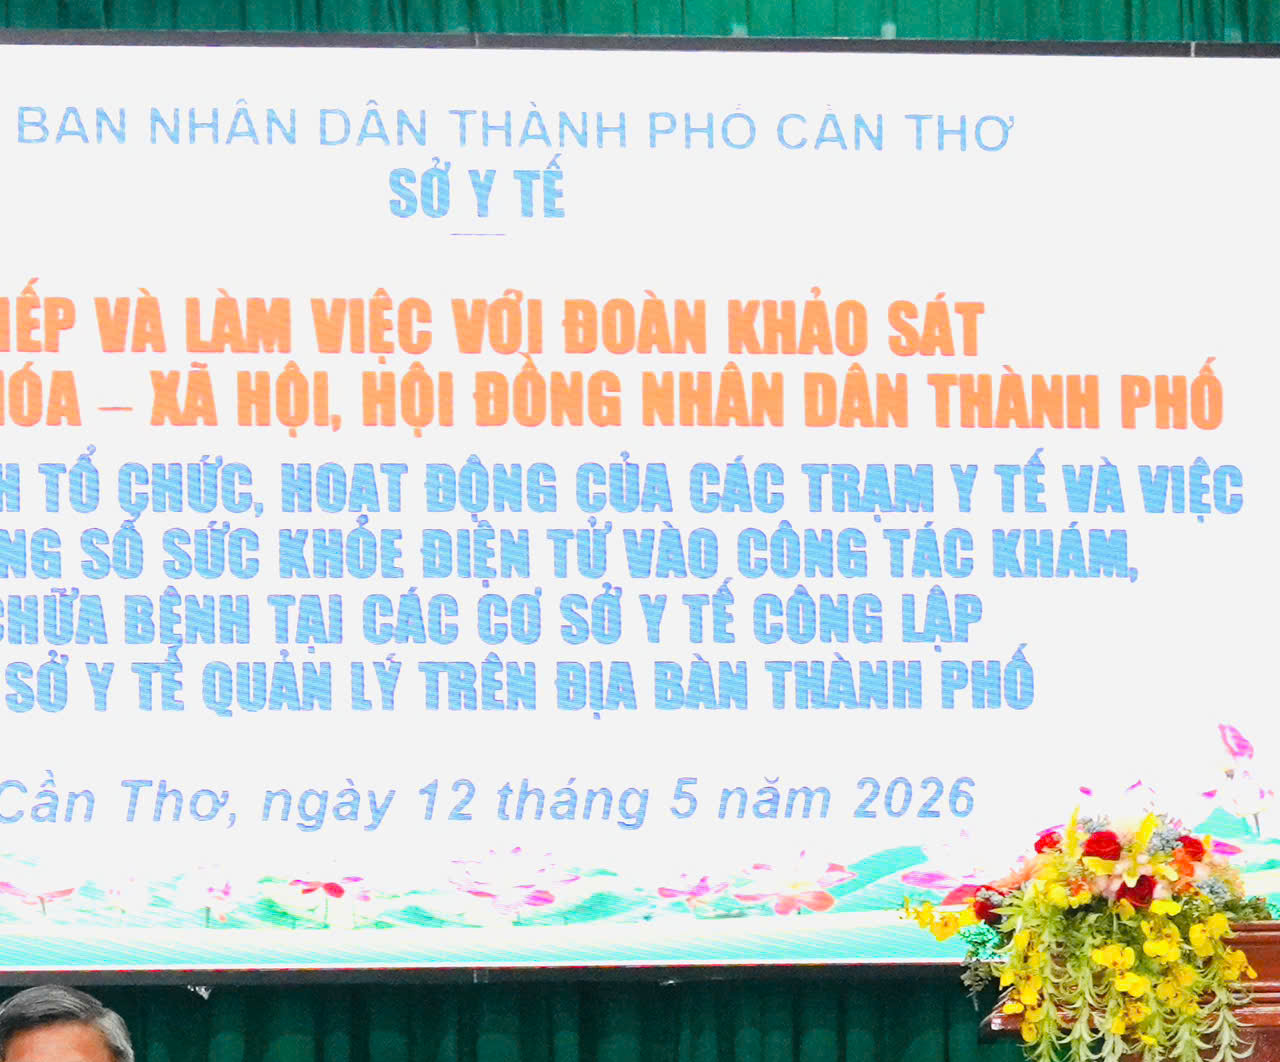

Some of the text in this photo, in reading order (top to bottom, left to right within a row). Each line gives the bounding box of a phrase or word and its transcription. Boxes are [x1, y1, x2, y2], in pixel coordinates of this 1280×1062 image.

[17, 106, 126, 144] BAN
[152, 98, 296, 144] NHÂN
[320, 100, 426, 146] DÂN
[448, 104, 627, 149] THÀNH
[904, 114, 1016, 152] THƠ
[389, 153, 565, 219] SỞ Y TẾ
[93, 288, 167, 354] VÀ
[185, 288, 292, 354] LÀM
[310, 288, 432, 365] VIỆC
[561, 290, 707, 355] ĐOÀN
[728, 286, 869, 357] KHẢO
[888, 291, 986, 357] SÁT
[148, 362, 219, 427] XÃ
[236, 360, 343, 440] HỘI,
[362, 361, 454, 437] HỘI
[472, 352, 622, 428] ĐỒNG
[641, 361, 784, 428] NHÂN
[804, 362, 909, 429] DÂN
[927, 364, 1101, 430] THÀNH
[1120, 356, 1224, 431] PHỐ
[38, 445, 100, 514] TỔ
[118, 456, 264, 518] CHỨC,
[424, 454, 557, 522] ĐỘNG
[576, 451, 672, 514] CỦA
[689, 456, 784, 514] CÁC
[801, 464, 934, 524] TRẠM
[950, 464, 979, 512] Y
[993, 448, 1047, 512] TẾ
[1062, 457, 1125, 513] VÀ
[1137, 456, 1244, 524] VIỆC
[162, 520, 260, 580] SỨC
[280, 514, 404, 580] KHỎE
[420, 520, 531, 588] ĐIỆN
[547, 516, 616, 580] TỬ
[624, 521, 719, 579] VÀO
[736, 520, 868, 579] CÔNG
[882, 521, 976, 579] TÁC
[992, 520, 1139, 583] KHÁM,
[124, 585, 250, 648] BỆNH
[267, 594, 344, 654] TẠI
[363, 586, 458, 646] CÁC
[478, 586, 543, 646] CƠ
[560, 582, 623, 646] SỞ
[640, 594, 668, 644] Y
[682, 578, 736, 644] TẾ
[753, 584, 883, 645] CÔNG
[902, 584, 983, 654] LẬP
[5, 650, 70, 713] SỞ
[85, 662, 115, 712] Y
[131, 646, 185, 712] TẾ
[202, 646, 332, 719] QUẢN
[352, 653, 402, 712] LÝ
[417, 648, 536, 712] TRÊN
[555, 661, 638, 720] ĐỊA
[654, 653, 748, 711] BÀN
[765, 652, 923, 712] THÀNH
[941, 643, 1036, 711] PHỐ
[122, 779, 240, 827] Thơ,
[264, 779, 396, 832] ngày
[419, 779, 476, 822] 12
[497, 777, 648, 830] tháng
[672, 778, 698, 819] 5
[718, 777, 831, 820] năm
[855, 776, 976, 820] 2026
